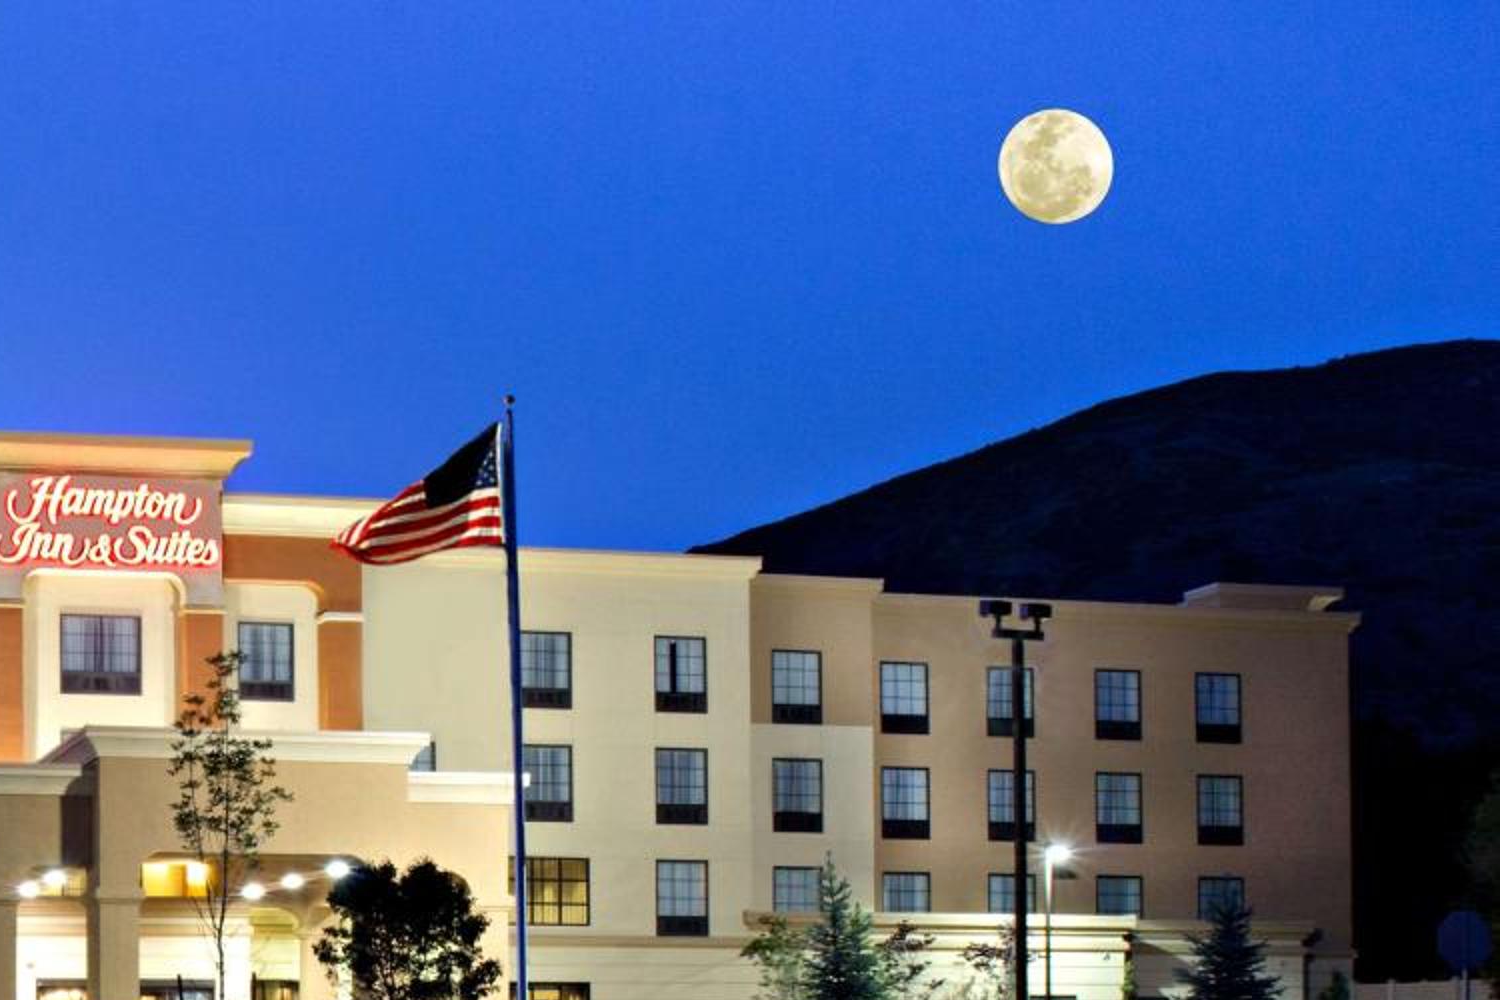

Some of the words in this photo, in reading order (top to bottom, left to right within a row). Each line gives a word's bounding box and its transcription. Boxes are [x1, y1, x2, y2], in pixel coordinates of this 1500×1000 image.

[6, 474, 202, 525] Hampton
[88, 533, 117, 567] &
[114, 524, 220, 567] Suites
